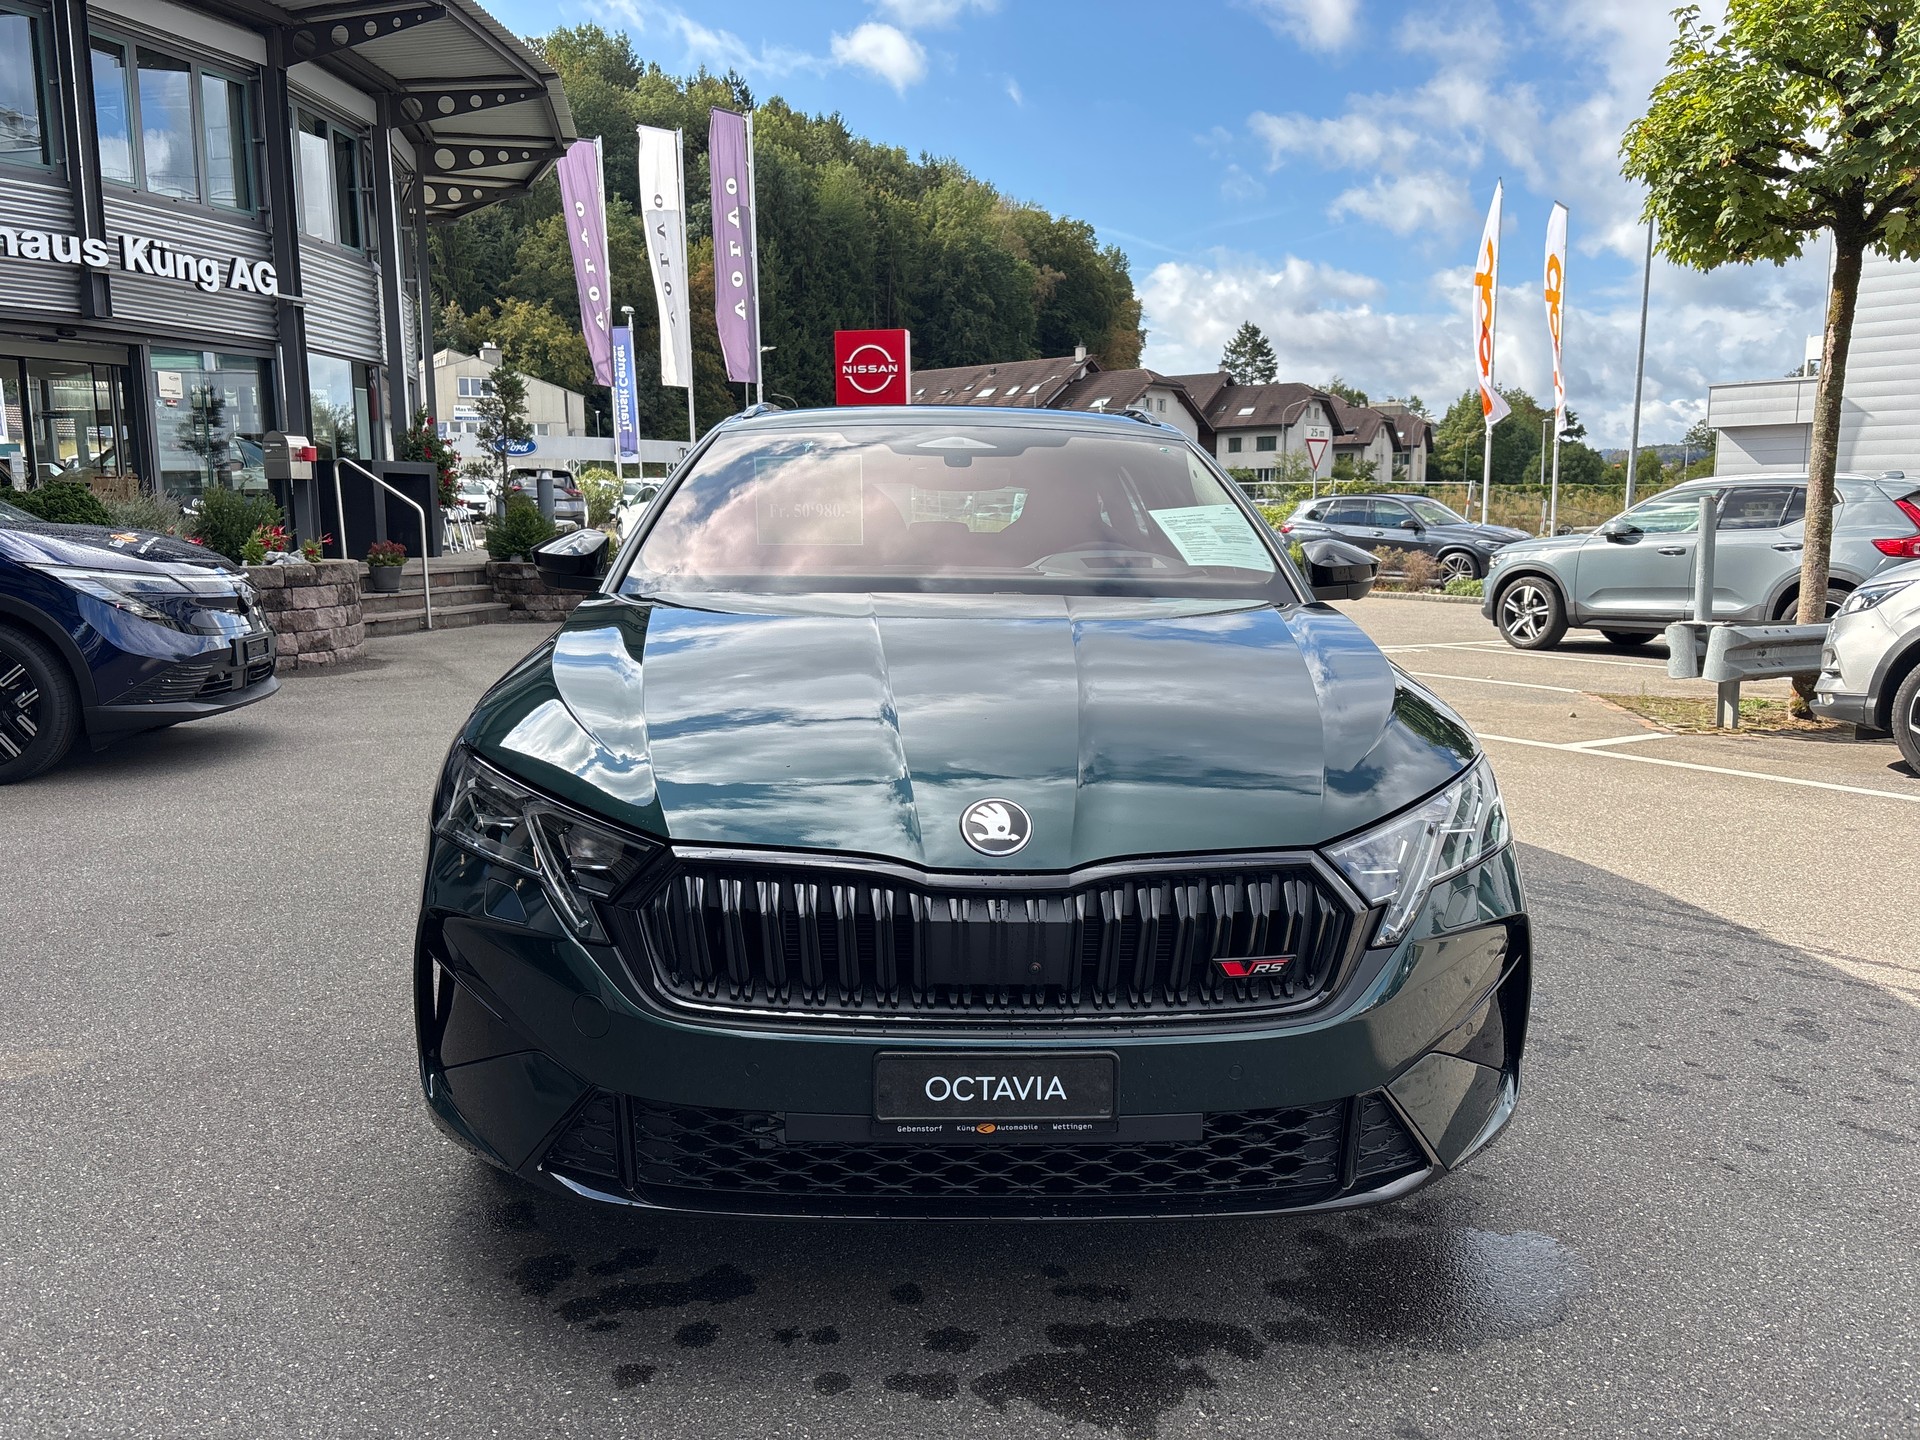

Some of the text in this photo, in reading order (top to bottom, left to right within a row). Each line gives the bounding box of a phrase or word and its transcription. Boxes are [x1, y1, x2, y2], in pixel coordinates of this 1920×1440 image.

[123, 235, 220, 293] Küng
[229, 257, 279, 296] AG
[842, 364, 898, 374] NISSAN
[1310, 428, 1318, 437] 25
[769, 503, 790, 518] Fr.
[925, 1075, 1068, 1101] OCTAVIA
[896, 1122, 1093, 1133] Gebenstorf Küng Automobile Wettingen
